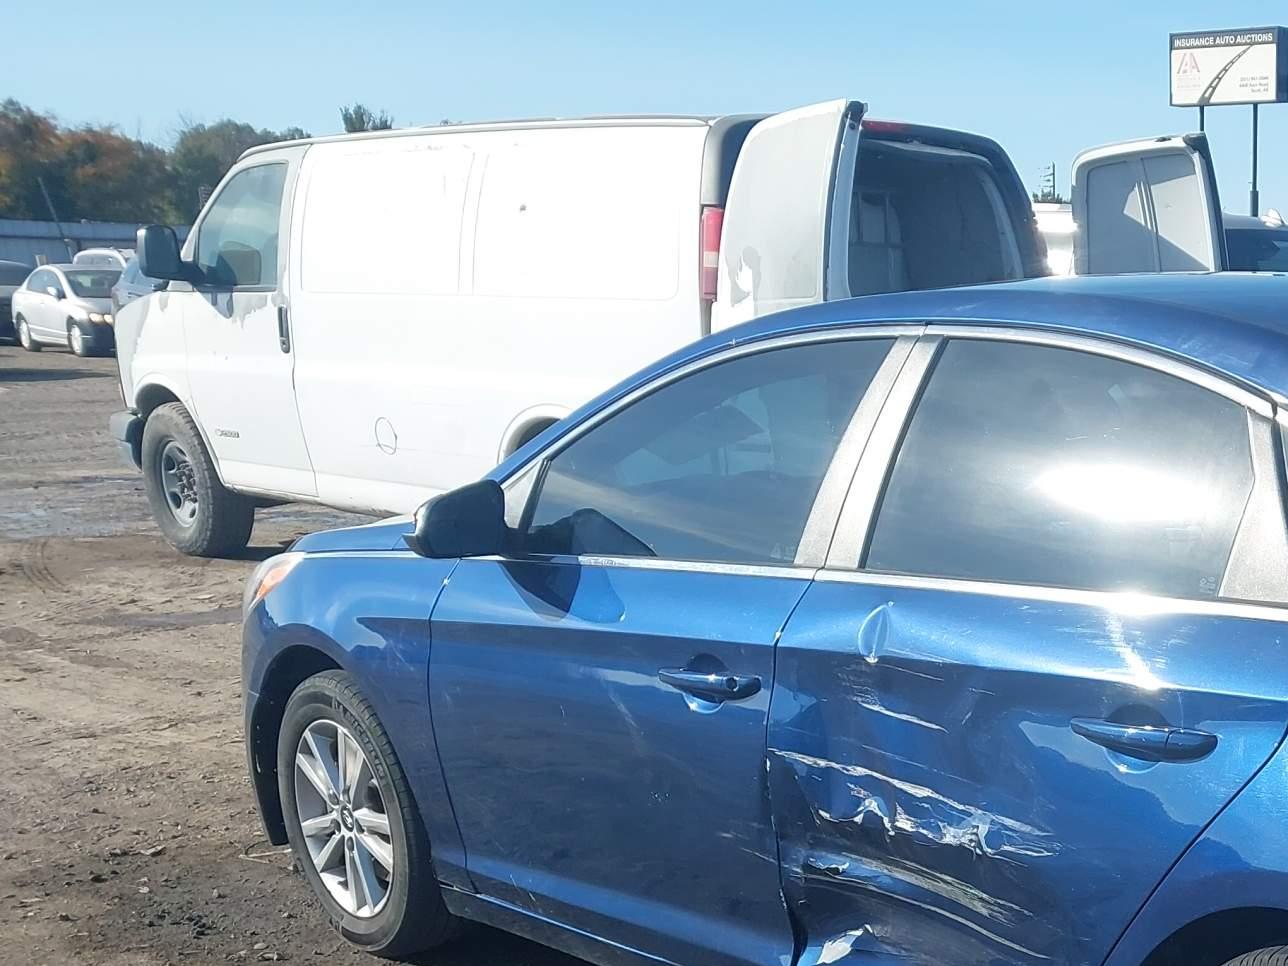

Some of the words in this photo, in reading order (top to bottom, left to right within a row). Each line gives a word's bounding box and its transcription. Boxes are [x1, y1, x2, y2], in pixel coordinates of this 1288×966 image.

[1174, 36, 1214, 47] INSURANCE
[1215, 35, 1235, 45] AUTO
[1236, 33, 1273, 43] AUCTIONS
